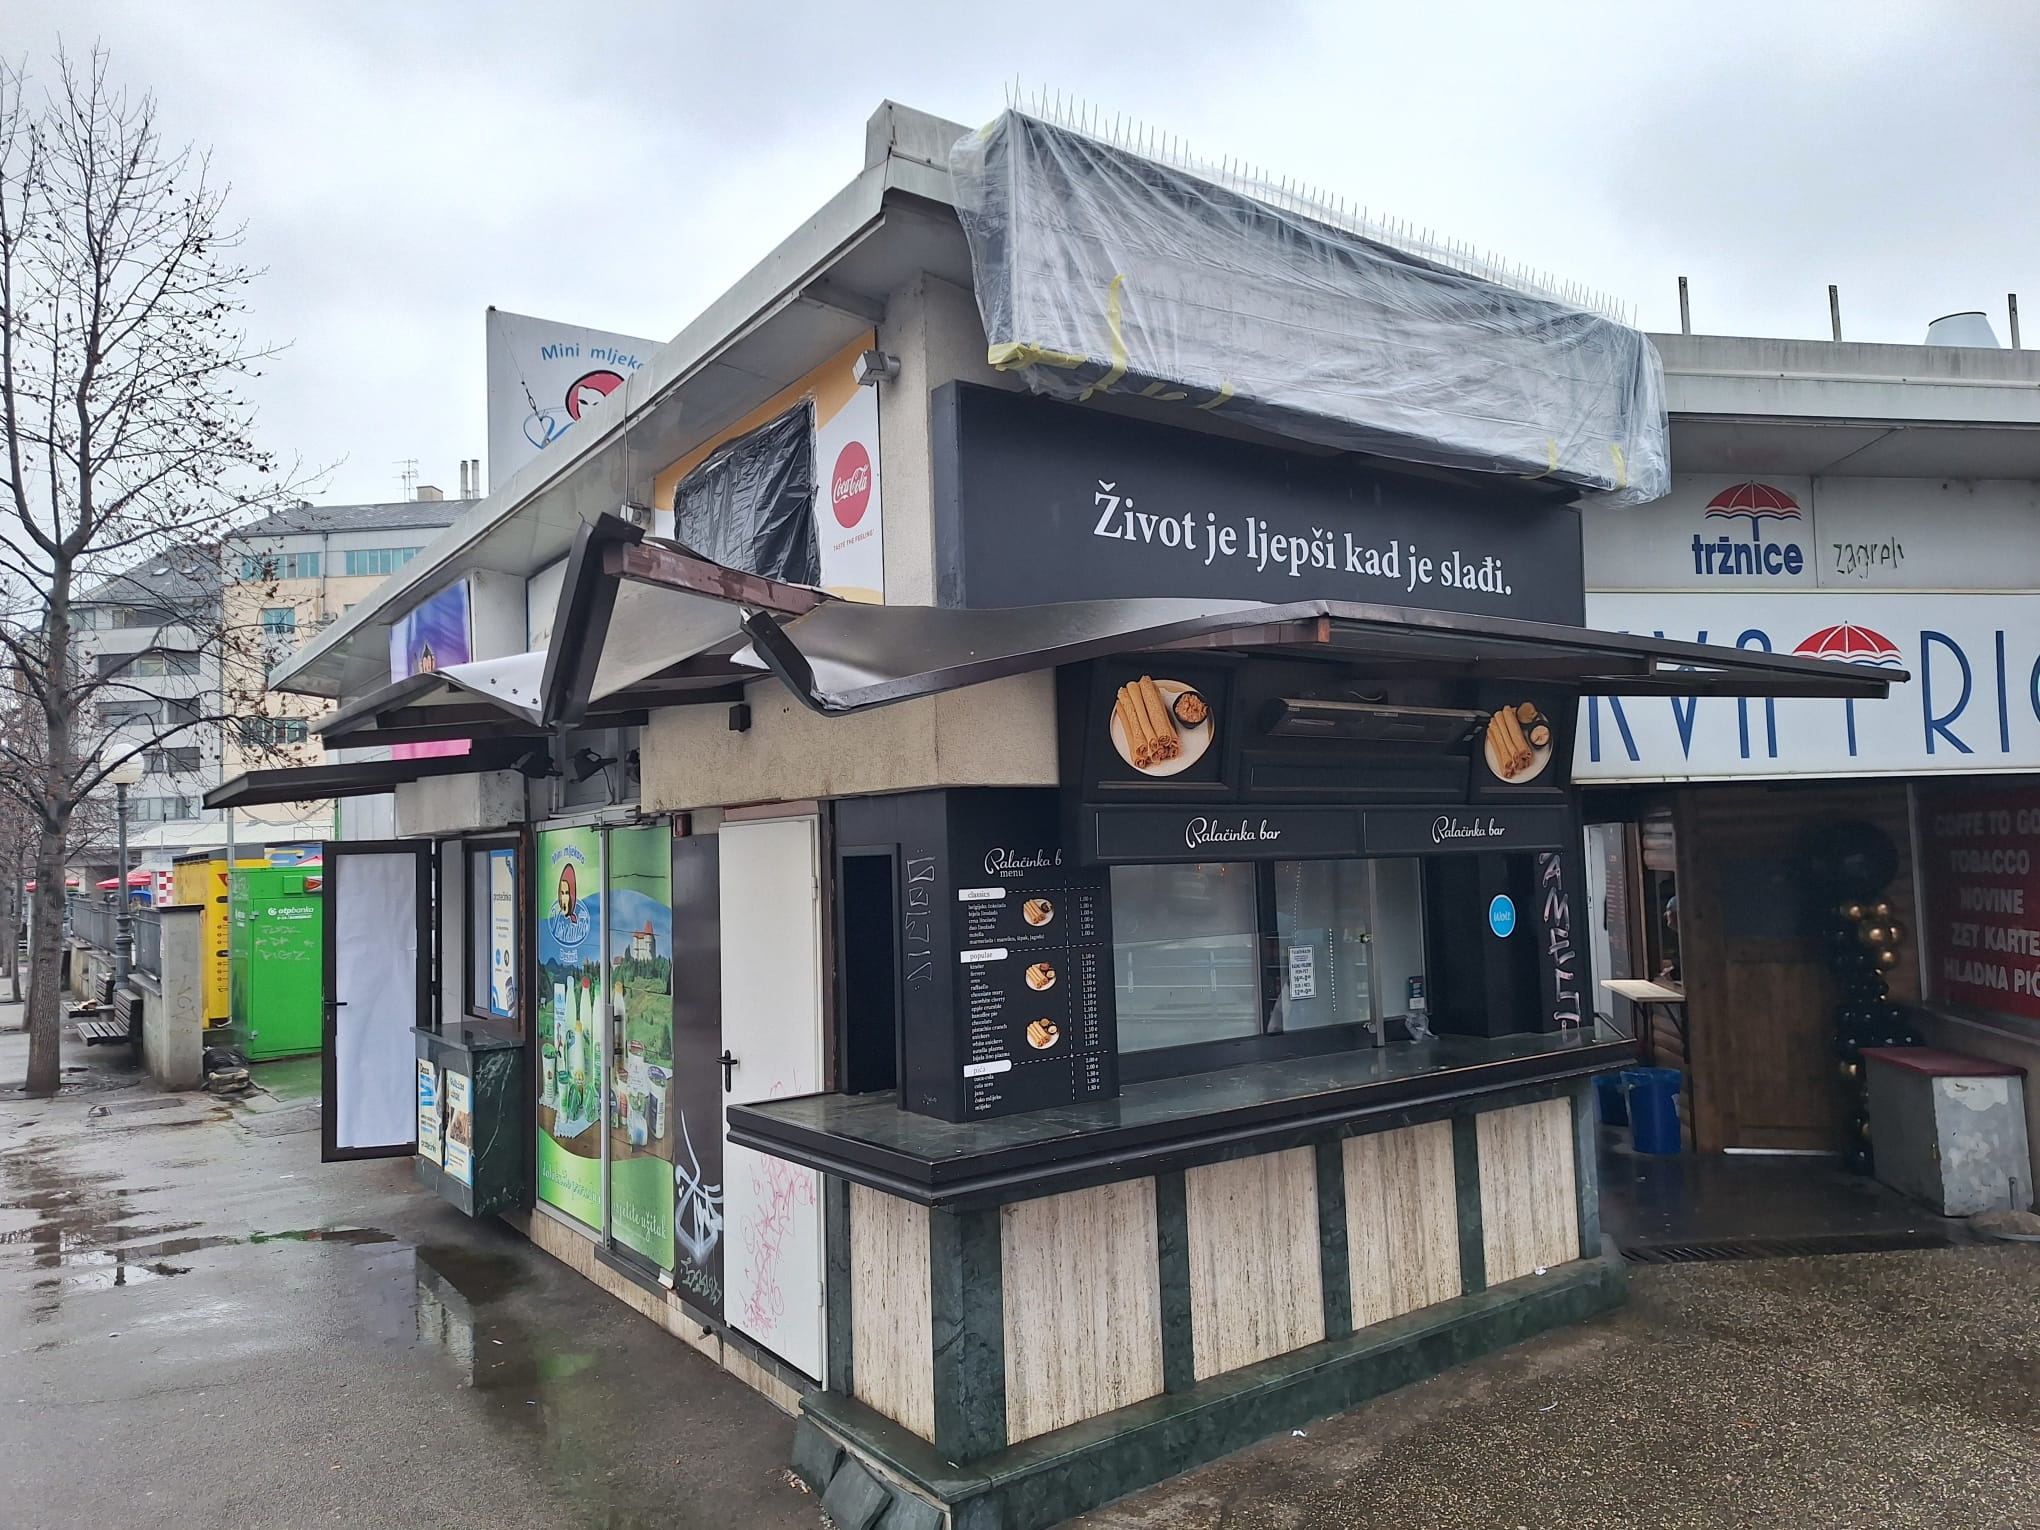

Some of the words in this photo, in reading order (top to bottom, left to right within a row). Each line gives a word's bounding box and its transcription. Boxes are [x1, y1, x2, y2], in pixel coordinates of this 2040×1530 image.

[541, 343, 580, 360] Mini
[833, 463, 869, 504] Coca-Cola
[833, 541, 846, 552] TASTE
[846, 537, 855, 547] THE
[1093, 479, 1197, 550] Život
[1204, 512, 1237, 566] je
[1246, 517, 1337, 577] ljepši
[1344, 532, 1402, 578] kad
[1407, 545, 1433, 592] je
[1441, 551, 1512, 596] slađi.
[1691, 534, 1804, 575] tržnice
[1185, 817, 1256, 849] Palačinka
[1260, 819, 1281, 840] bar
[1432, 815, 1486, 844] Palačinka
[1488, 818, 1506, 836] bar
[1989, 810, 2011, 835] TO
[984, 847, 1052, 875] Palačinka
[1000, 869, 1024, 878] menu
[1950, 849, 2031, 875] TOBACCO
[1960, 887, 2024, 915] NOVINE
[1493, 911, 1512, 922] Wolt
[1951, 922, 1981, 947] ZET
[1984, 926, 2040, 957] KARTE
[970, 951, 993, 961] popular
[1944, 957, 2009, 991] HLADNA
